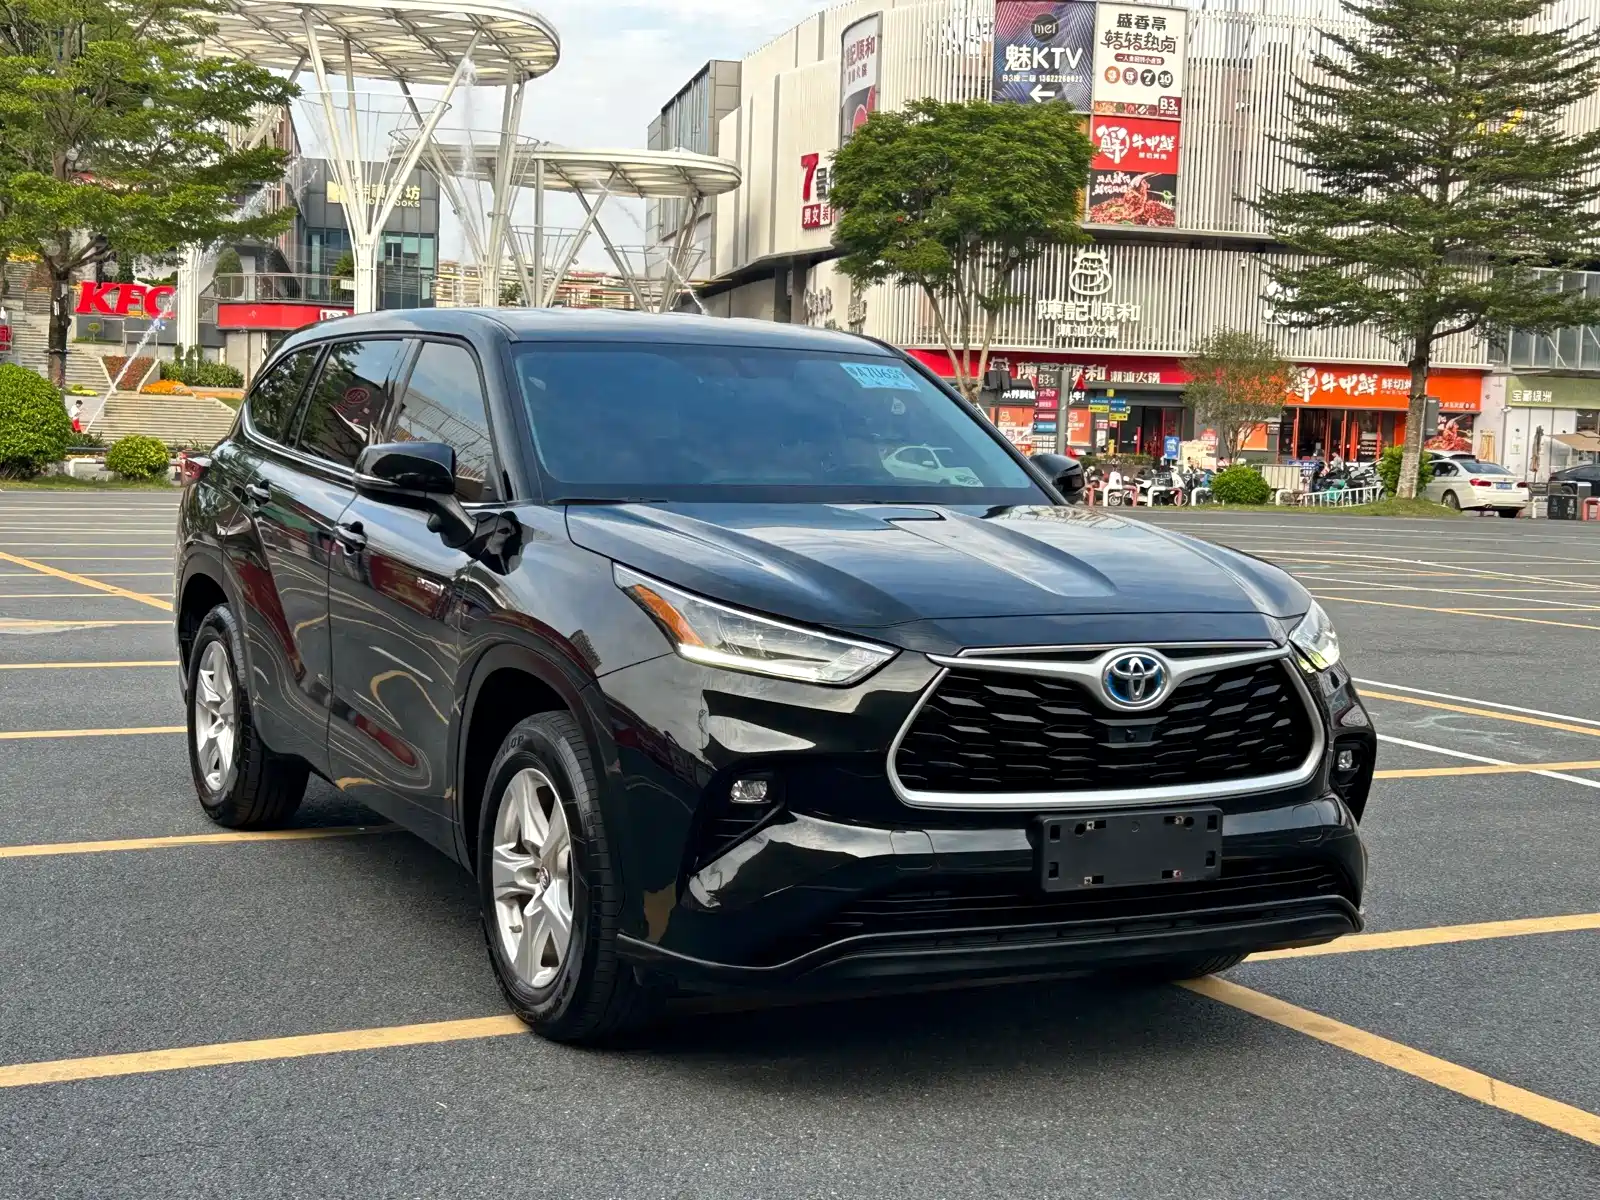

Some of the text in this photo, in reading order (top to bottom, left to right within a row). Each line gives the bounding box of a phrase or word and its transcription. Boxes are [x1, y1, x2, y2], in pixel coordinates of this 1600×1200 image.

[1034, 24, 1056, 34] mei
[1116, 13, 1167, 31] 盛香亭
[1100, 29, 1176, 54] 转转热卤
[1004, 44, 1083, 71] 魅KTV
[1143, 72, 1153, 82] 7
[1160, 74, 1171, 83] 10
[74, 281, 176, 320] KFC
[1110, 371, 1161, 384] 潮汕火锅
